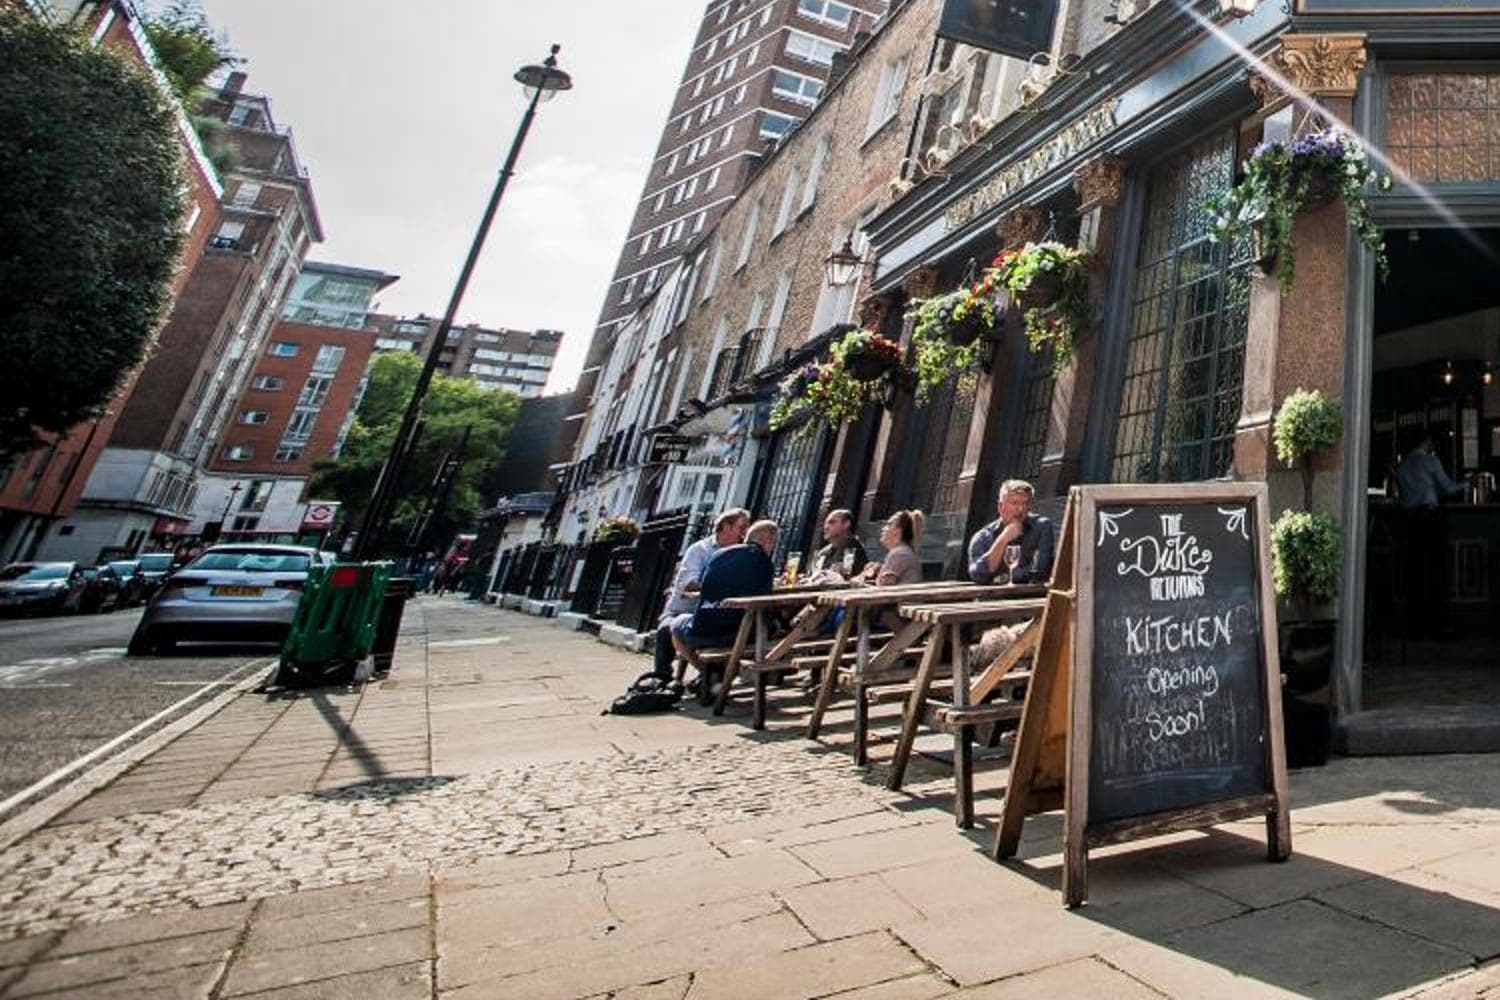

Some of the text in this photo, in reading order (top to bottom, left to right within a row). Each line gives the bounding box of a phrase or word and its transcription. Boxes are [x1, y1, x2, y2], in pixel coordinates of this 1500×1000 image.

[1160, 513, 1187, 536] THE
[1149, 575, 1205, 601] RETURNS
[1148, 664, 1219, 697] Opening
[1145, 698, 1208, 742] Soon!
